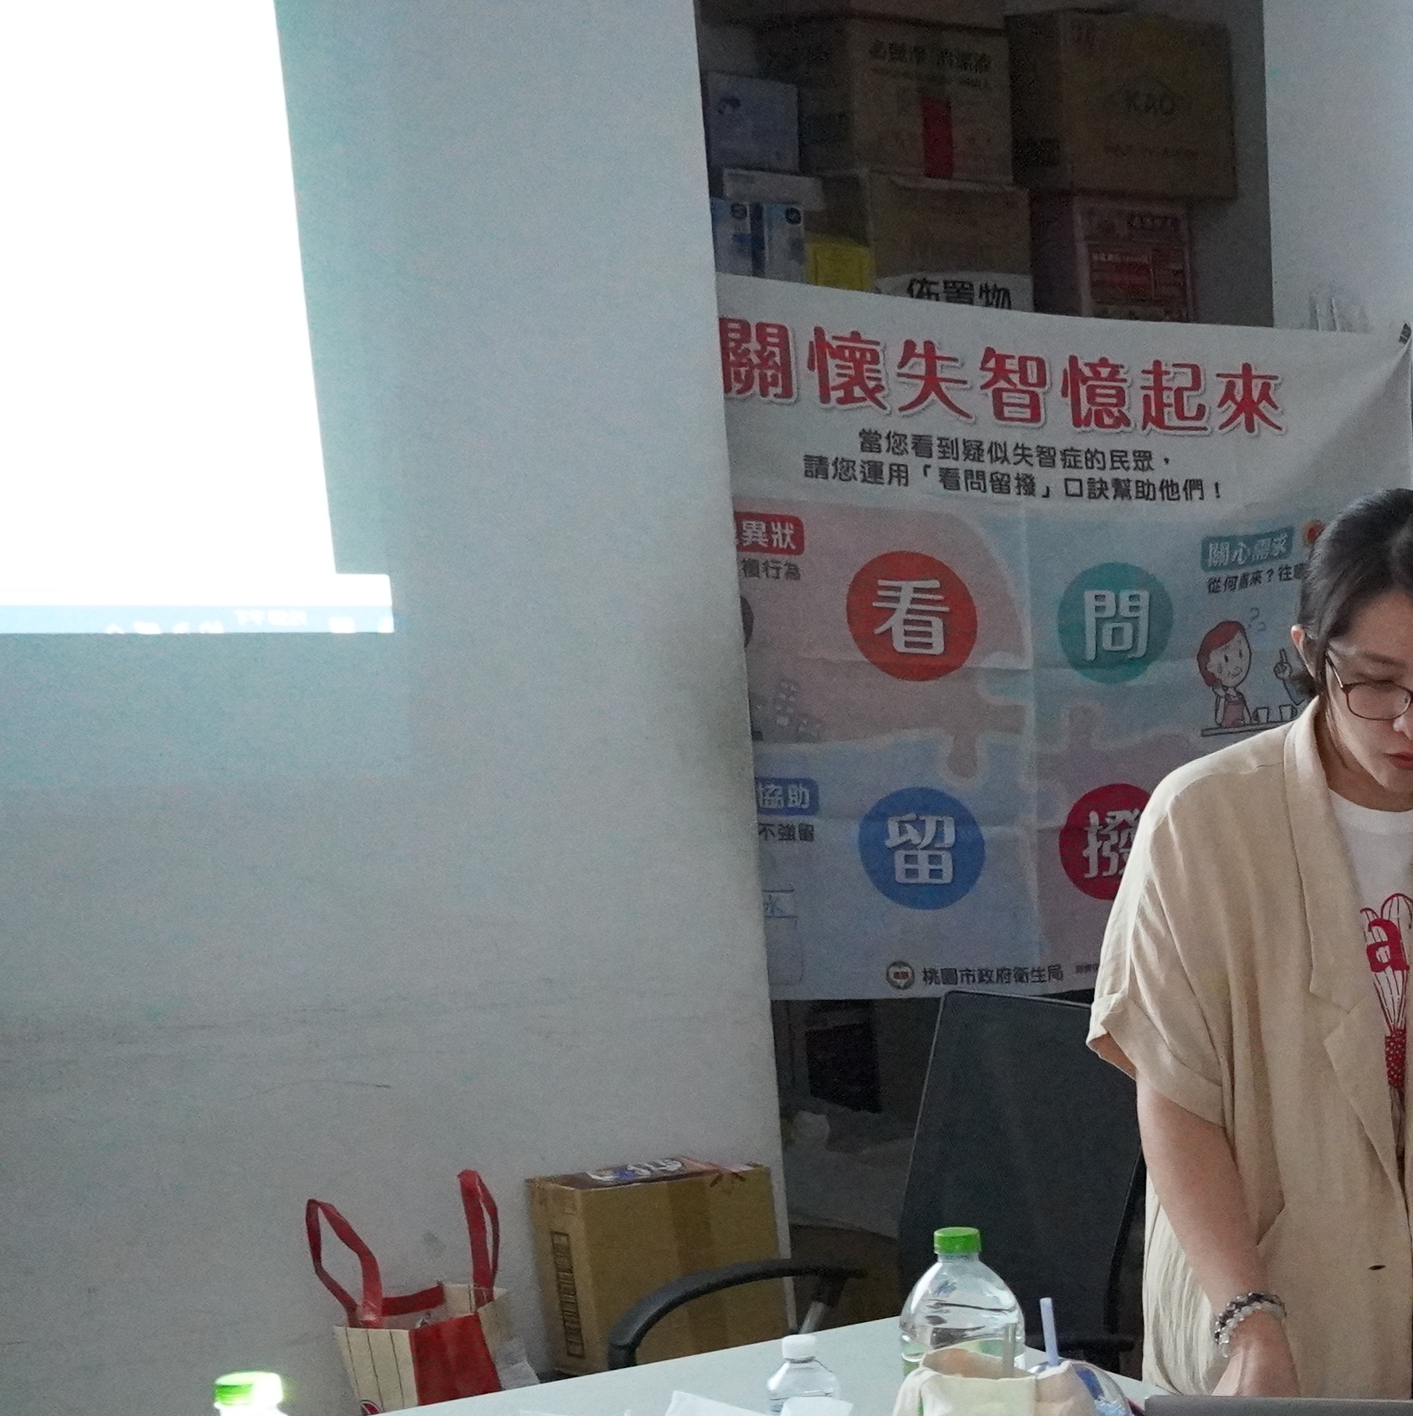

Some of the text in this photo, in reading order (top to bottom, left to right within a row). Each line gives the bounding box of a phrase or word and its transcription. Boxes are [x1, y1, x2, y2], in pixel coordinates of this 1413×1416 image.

[718, 314, 1284, 434] 關懷失智憶起來
[858, 428, 1171, 472] 當您看到疑似失智症的民眾，
[736, 520, 797, 550] 異狀
[871, 578, 951, 657] 看
[1082, 589, 1150, 661] 問
[884, 812, 956, 885] 留
[922, 963, 1064, 986] 桃園市政府衛生局
